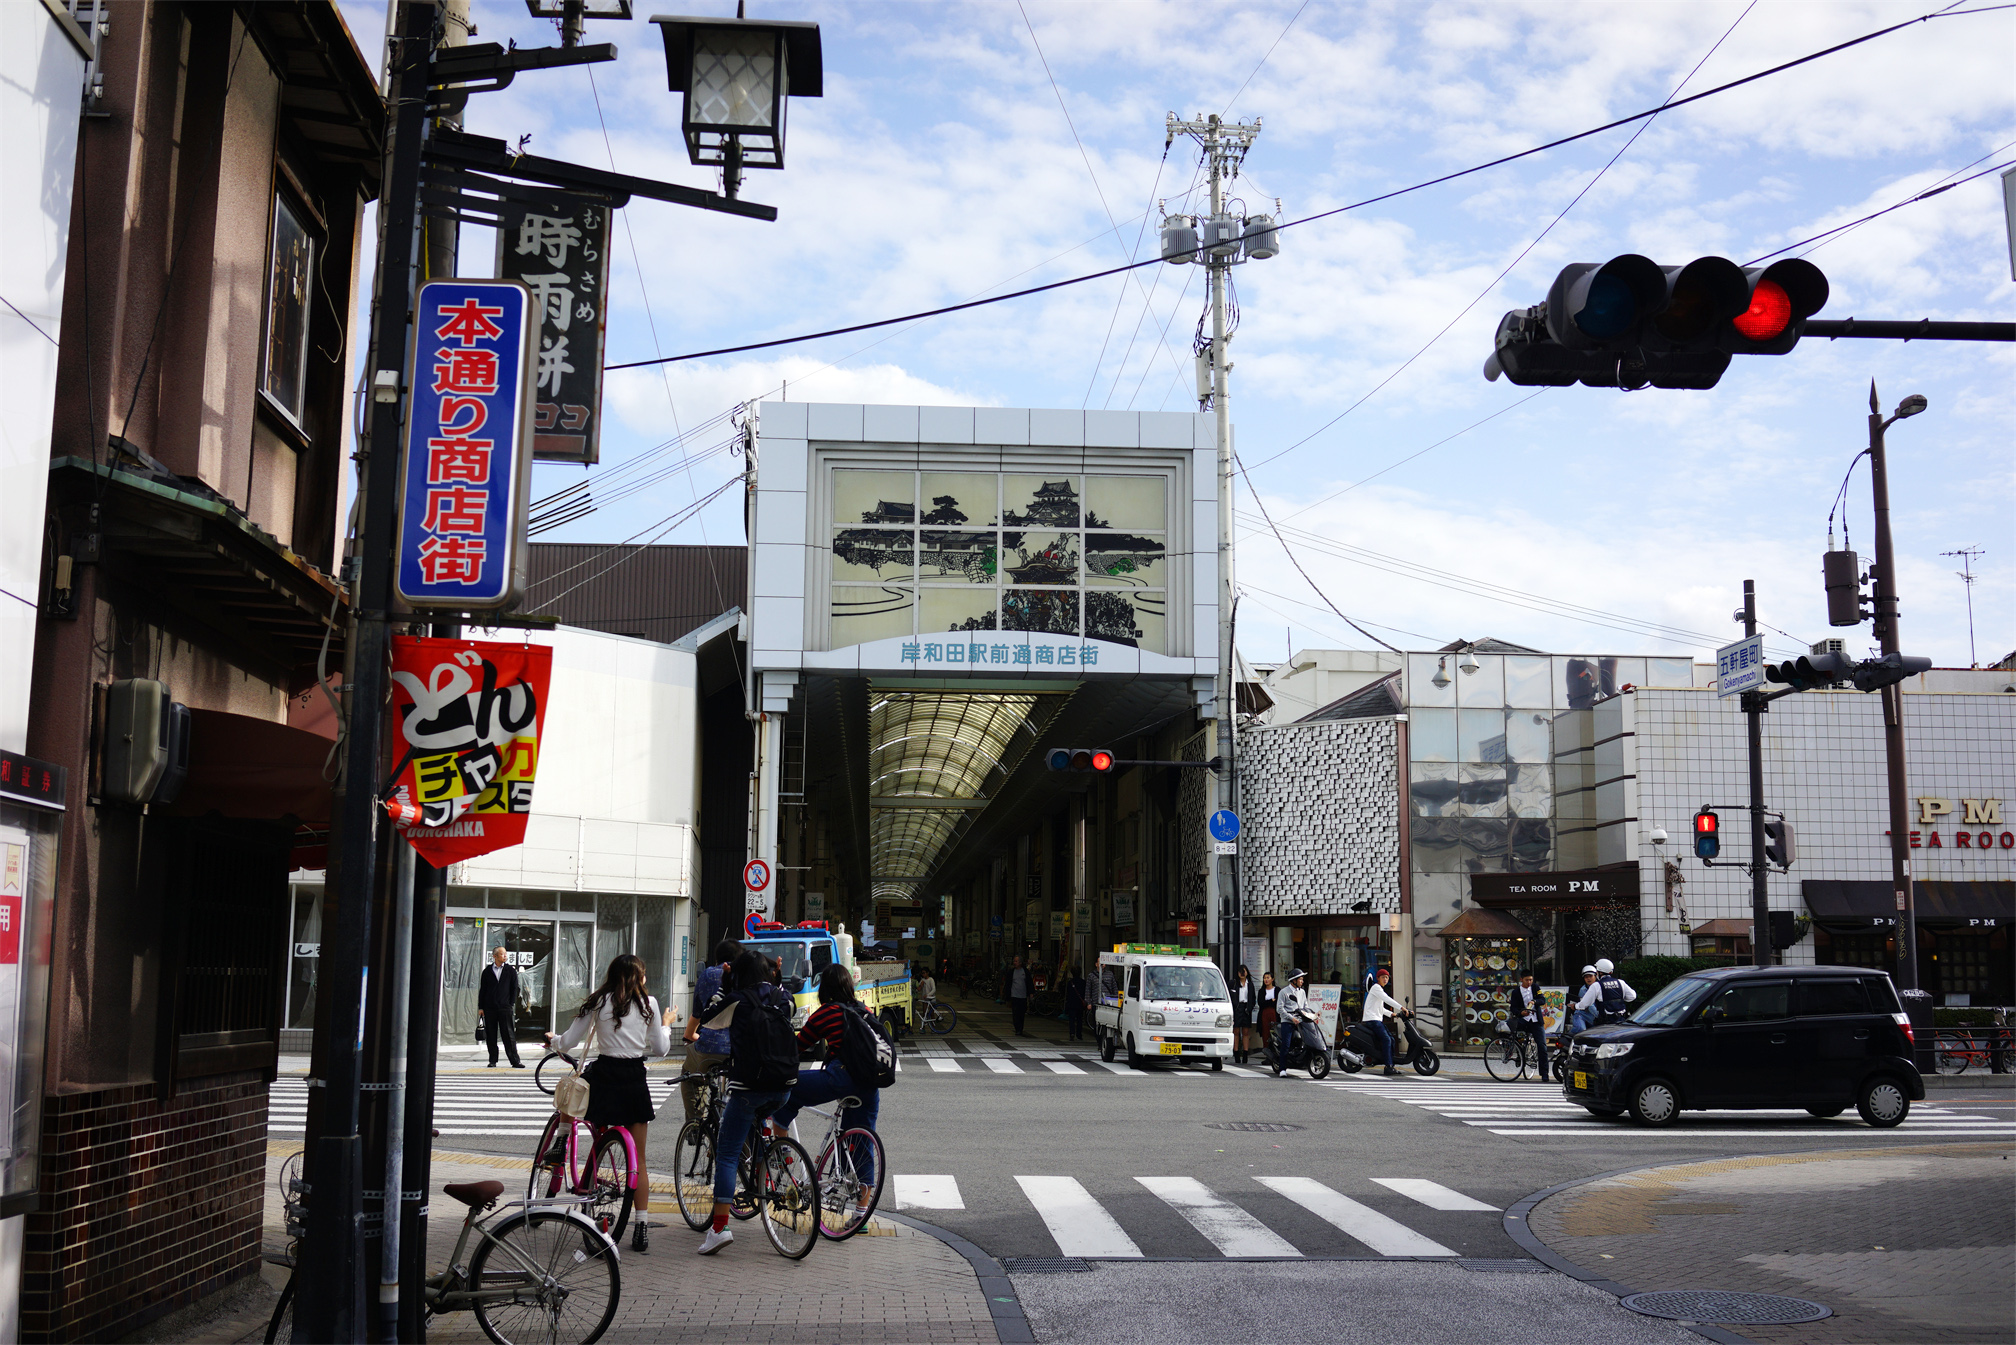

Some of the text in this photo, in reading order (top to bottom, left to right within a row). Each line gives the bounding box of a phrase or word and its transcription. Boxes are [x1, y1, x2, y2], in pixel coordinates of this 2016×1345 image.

[575, 208, 600, 323] むらさめ
[417, 298, 504, 586] 本通り商店街
[901, 642, 1099, 666] 岸和田駅前通商店街
[1720, 644, 1758, 676] 五軒屋町
[1569, 880, 1600, 892] PM
